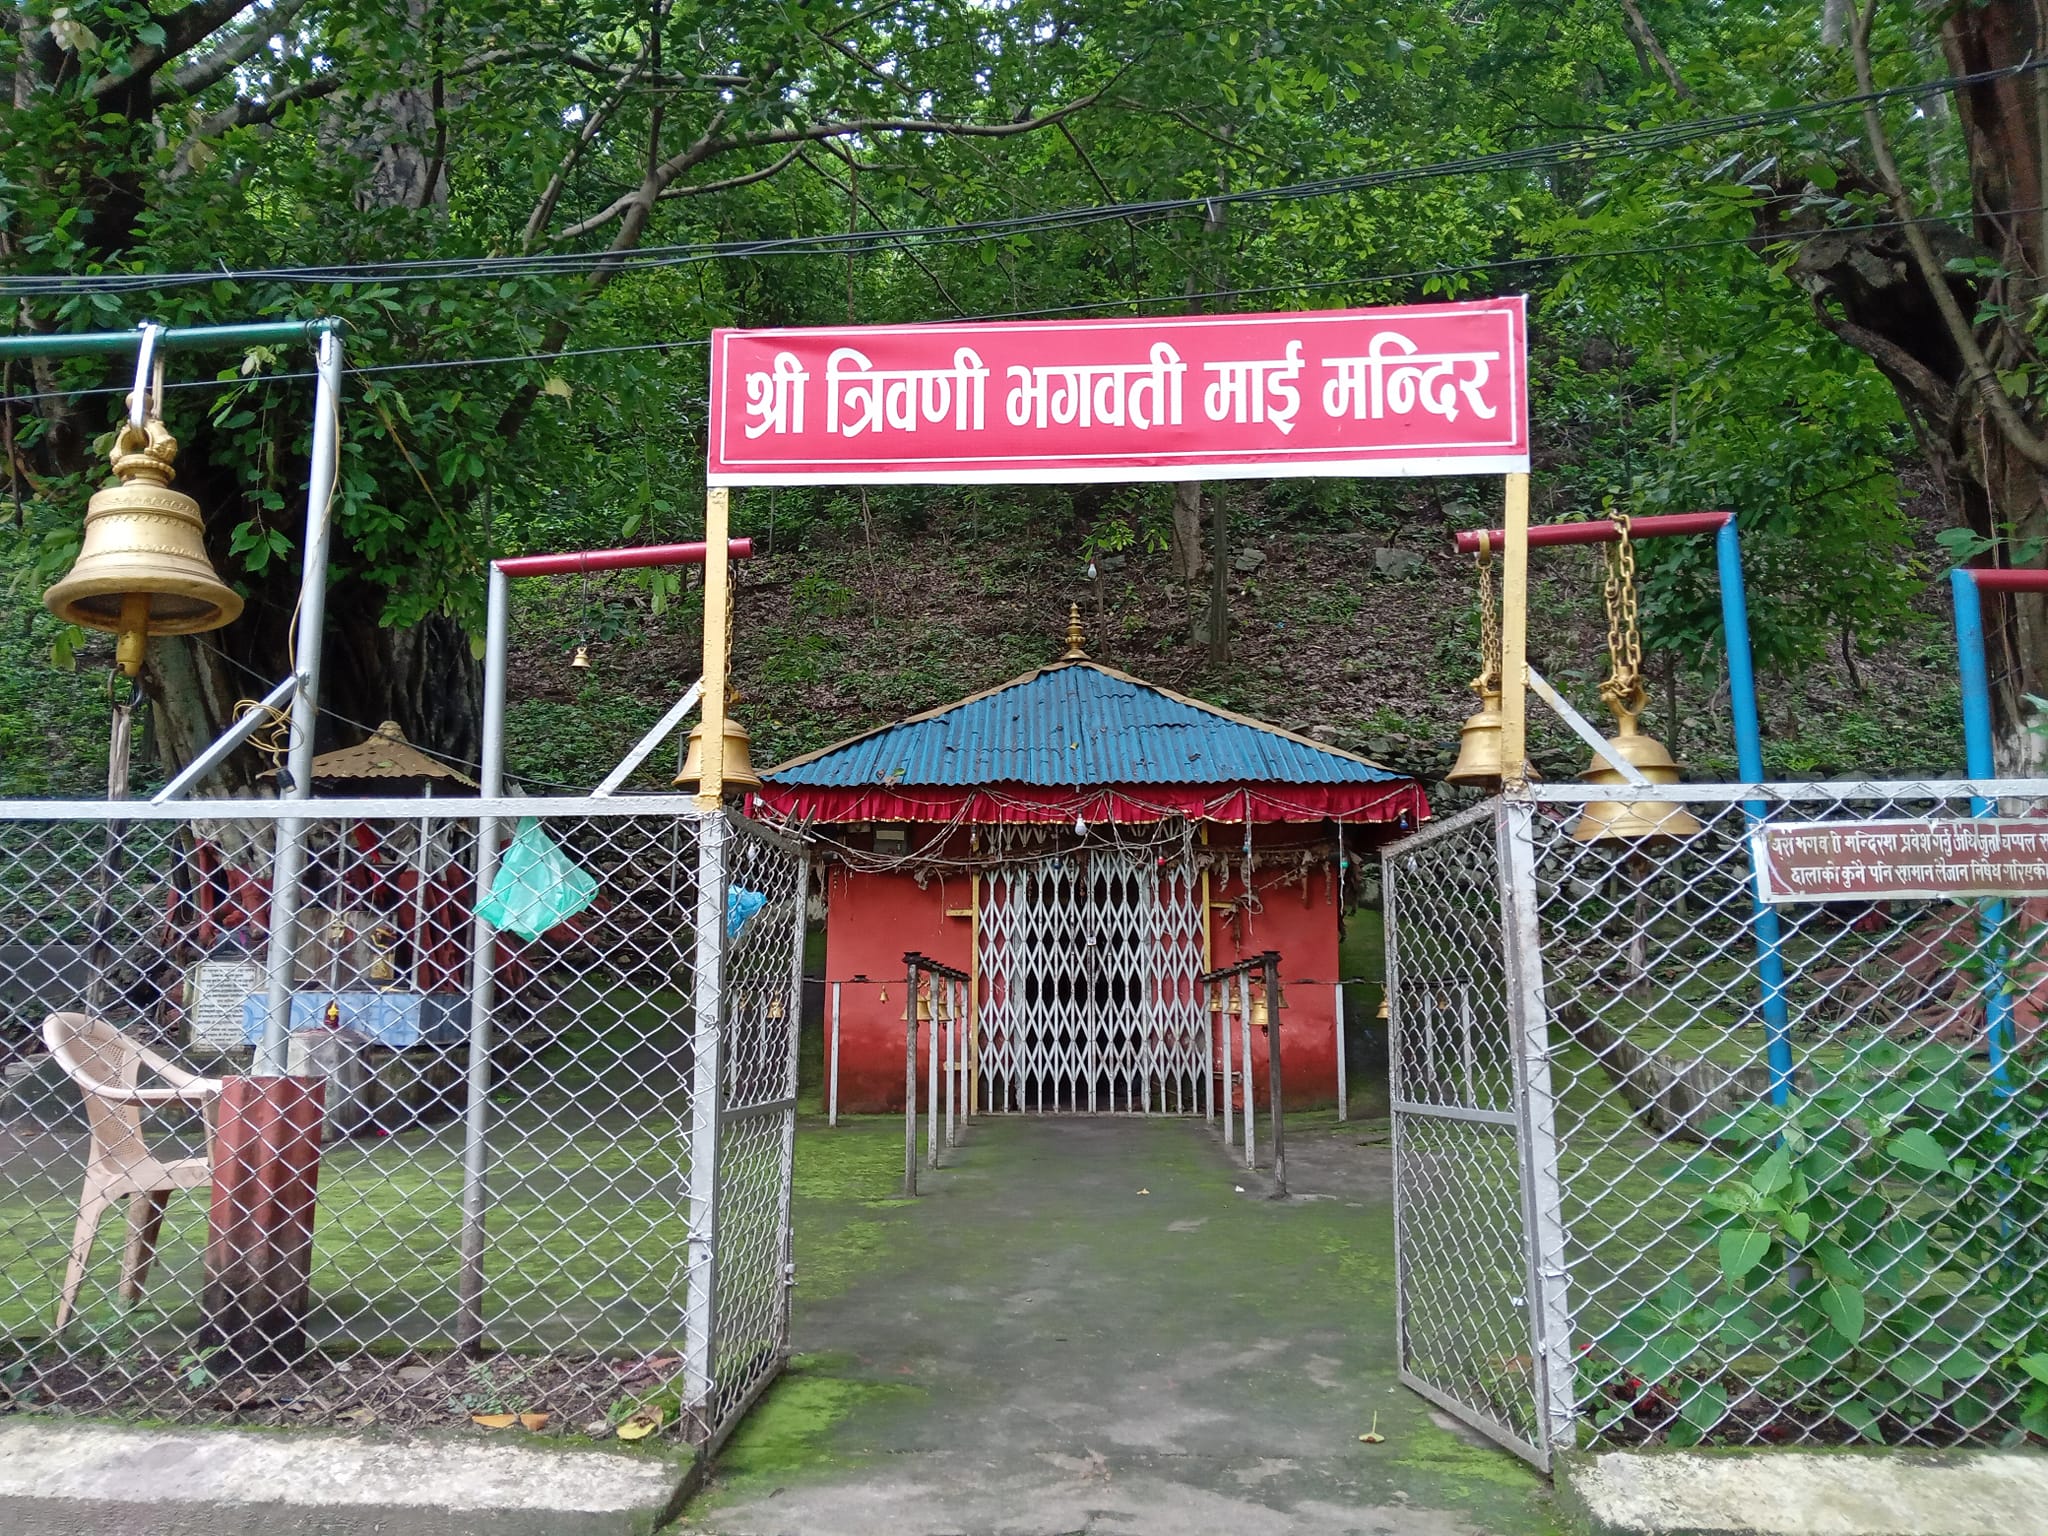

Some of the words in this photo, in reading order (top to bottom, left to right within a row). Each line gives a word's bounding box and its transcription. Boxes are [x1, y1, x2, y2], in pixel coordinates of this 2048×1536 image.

[744, 352, 809, 439] श्री
[1006, 342, 1187, 430] भगवती
[1204, 340, 1305, 435] माई
[1322, 331, 1500, 421] मन्दिर
[1844, 830, 1898, 856] मन्दिरमा
[1900, 828, 1932, 854] प्रवेश
[2001, 833, 2037, 854] चप्पल
[1841, 859, 1866, 888] कुनै
[1868, 861, 1894, 884] पनि
[1895, 863, 1934, 885] सामान
[1970, 858, 2001, 882] निषेध
